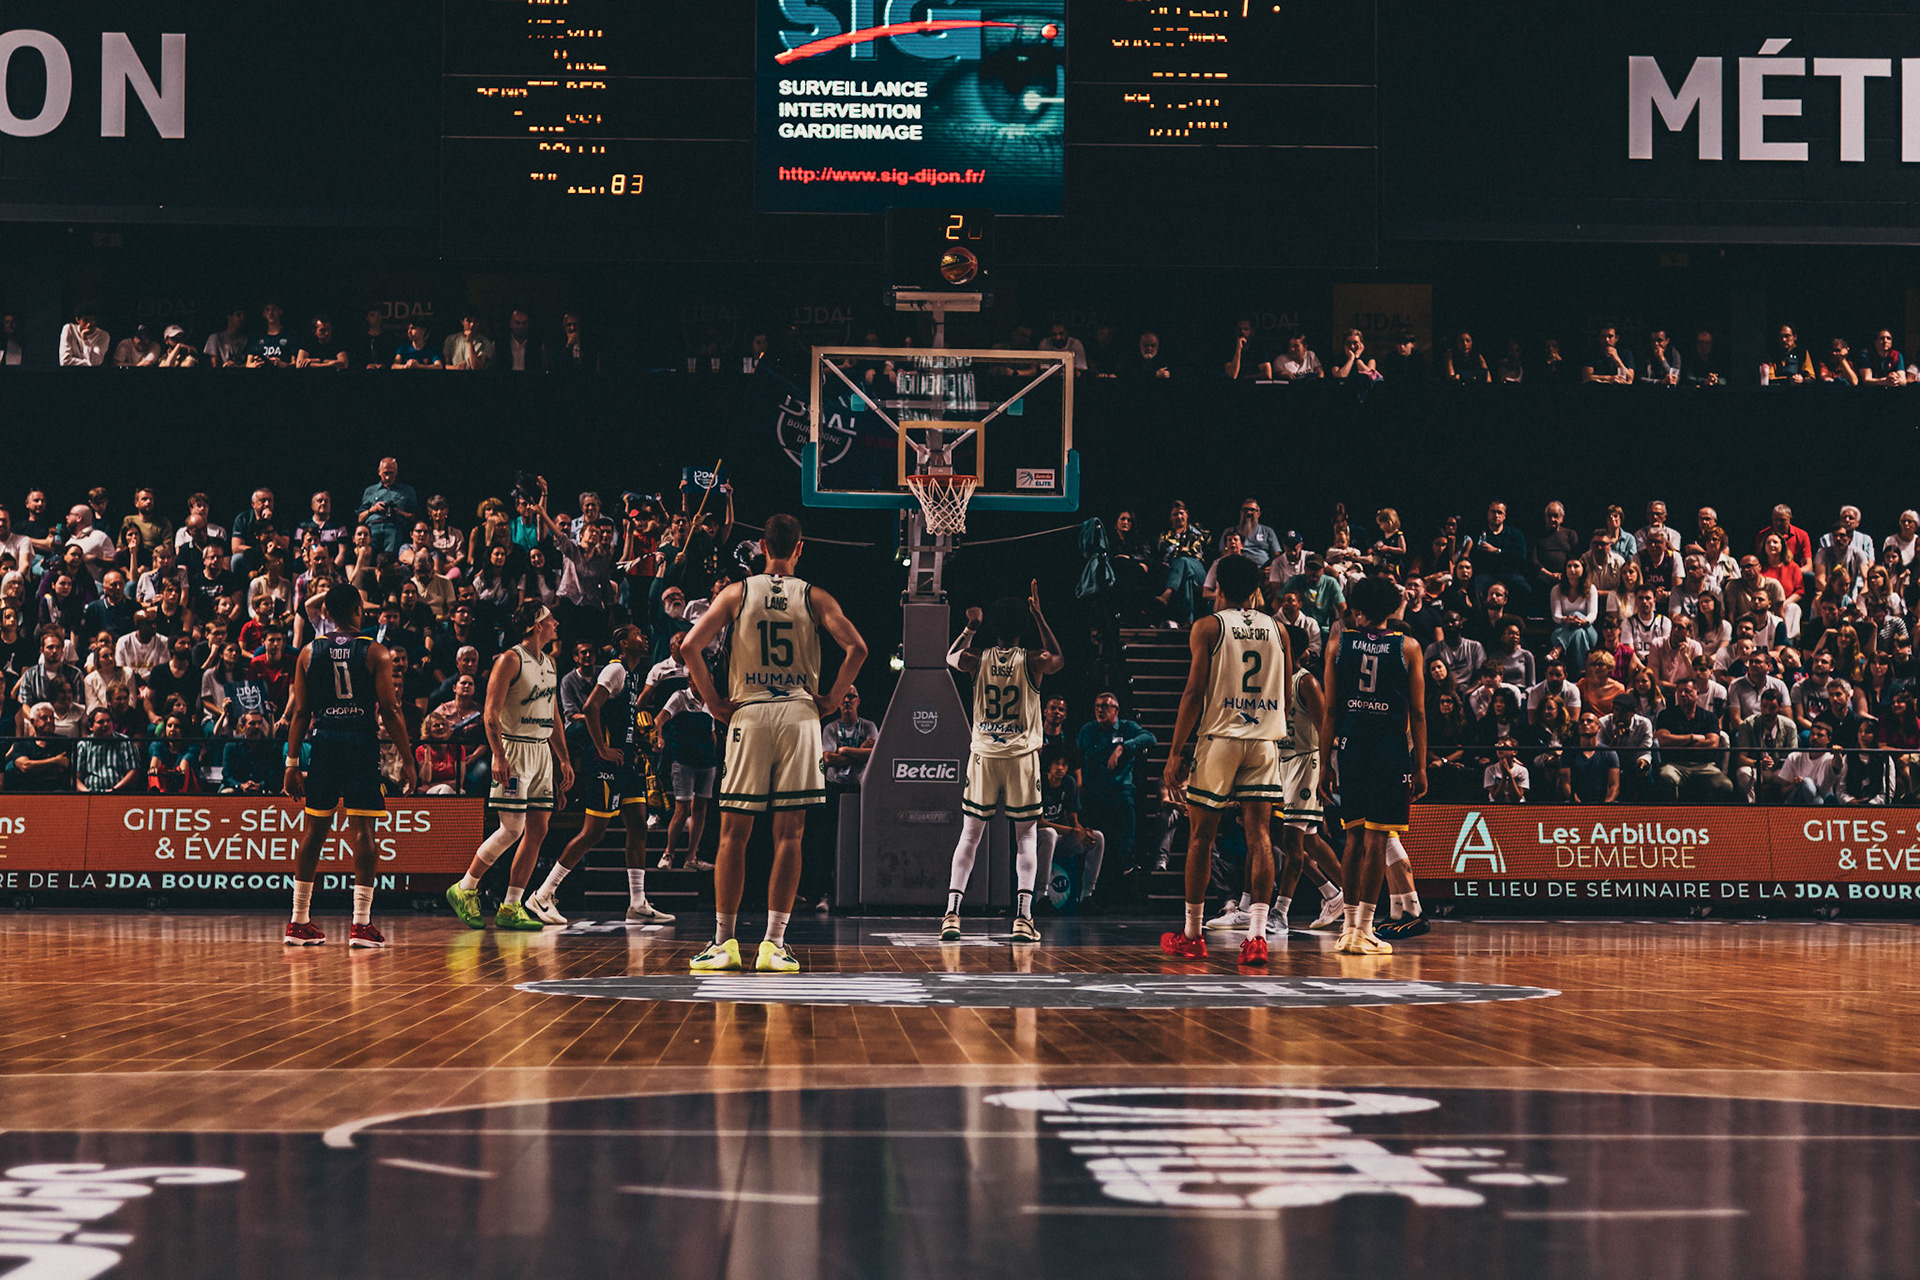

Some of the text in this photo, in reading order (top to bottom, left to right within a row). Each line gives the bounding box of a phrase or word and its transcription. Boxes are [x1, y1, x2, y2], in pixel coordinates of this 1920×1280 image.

[0, 29, 186, 139] ON
[778, 79, 928, 98] SURVEILLANCE
[1628, 38, 1920, 162] MÉT
[778, 102, 922, 120] INTERVENTION
[778, 123, 923, 141] GARDIENNAGE
[778, 166, 985, 187] http://www.sig-dijon.fr/
[263, 346, 281, 356] JDA
[765, 596, 788, 611] LANG
[757, 620, 793, 667] 15
[1231, 626, 1270, 641] BEAUFORT
[333, 661, 353, 699] 0
[745, 672, 808, 686] HUMAN
[1242, 650, 1261, 693] 2
[1359, 653, 1378, 692] 9
[985, 684, 1020, 720] 32
[1224, 697, 1278, 711] HUMAN
[1347, 699, 1389, 711] CHOPARD
[732, 727, 742, 742] 15
[979, 721, 1024, 734] HUMAN
[895, 763, 956, 779] Betclic
[124, 807, 211, 832] GITES
[1538, 822, 1710, 845] Les Arbillons
[1803, 819, 1889, 842] GITES
[155, 832, 397, 861] & ÉVÉNEENS
[1556, 846, 1696, 869] DEMEURE
[1838, 847, 1857, 870] &
[29, 872, 60, 889] DE
[69, 872, 97, 889] LA
[105, 873, 152, 889] JDA
[162, 873, 296, 890] BOURGOGN
[1454, 881, 1479, 897] LE
[1489, 881, 1537, 898] LIEU
[1548, 882, 1577, 898] DE
[1586, 879, 1711, 898] SÉMINAIRE
[1720, 883, 1750, 898] DE
[1759, 883, 1787, 899] LA
[1795, 883, 1840, 899] JDA
